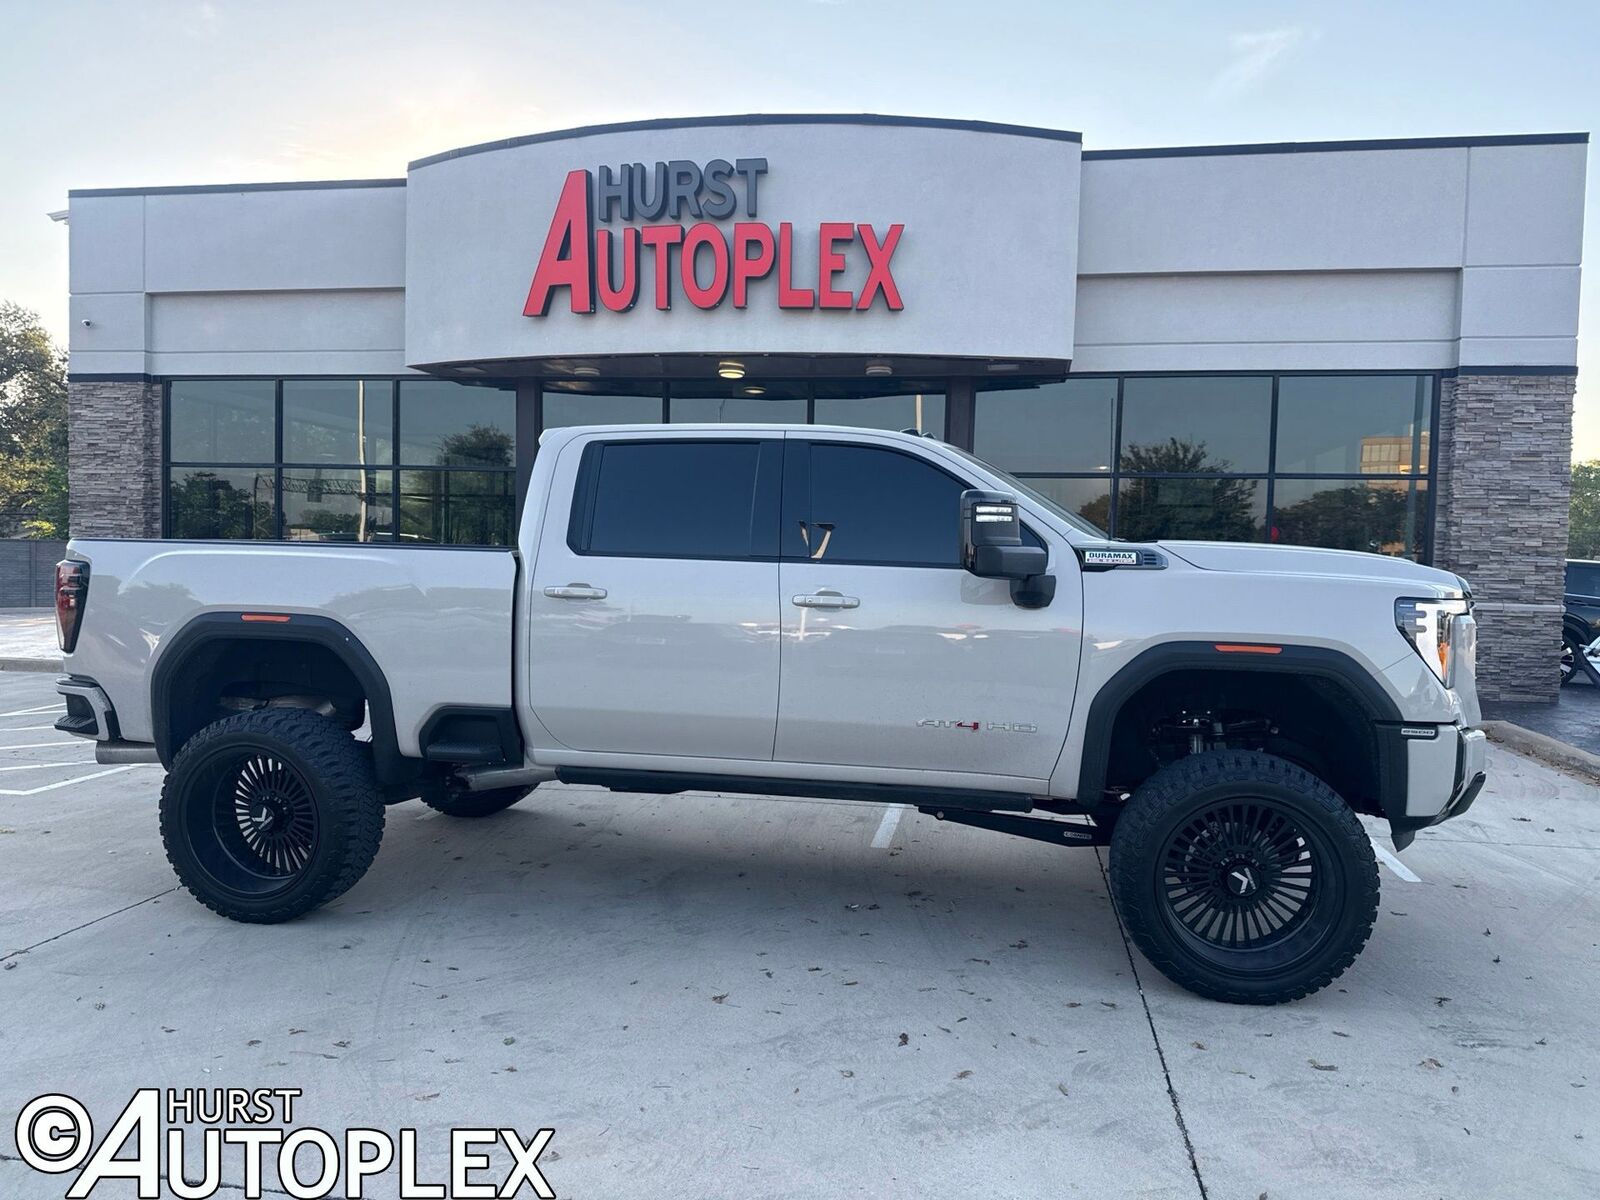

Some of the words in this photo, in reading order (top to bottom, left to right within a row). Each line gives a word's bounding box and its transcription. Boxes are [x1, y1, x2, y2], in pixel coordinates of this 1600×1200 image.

[598, 158, 768, 222] HURST
[522, 168, 905, 317] AUTOPLEX
[916, 719, 980, 731] AT4
[986, 722, 1038, 733] HD
